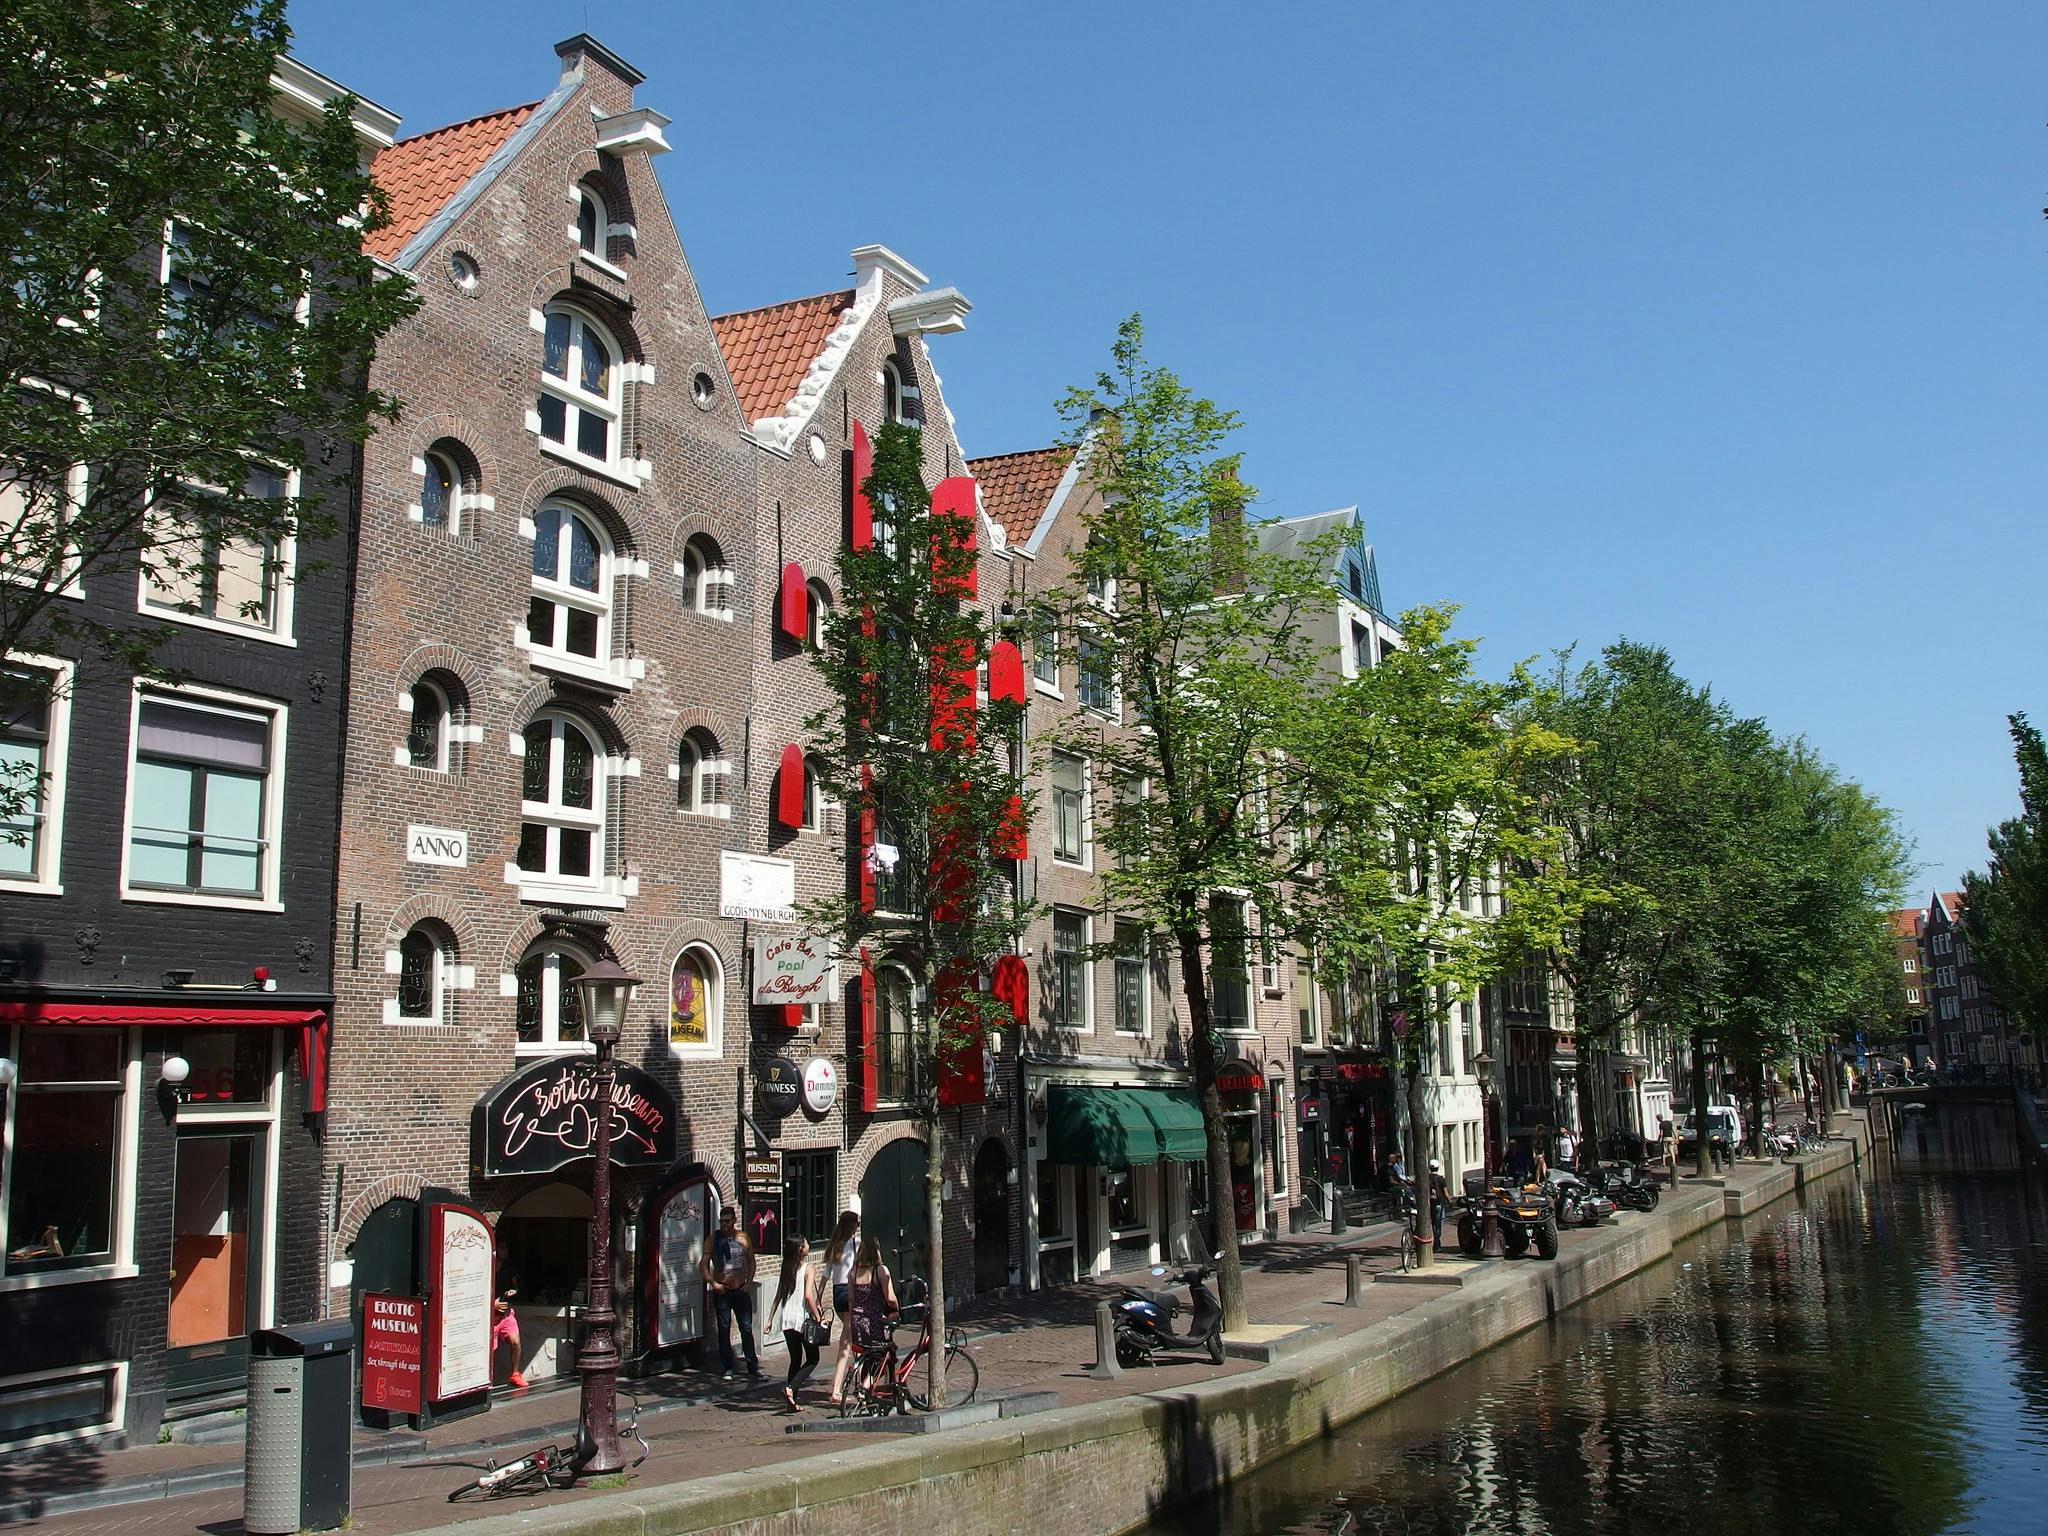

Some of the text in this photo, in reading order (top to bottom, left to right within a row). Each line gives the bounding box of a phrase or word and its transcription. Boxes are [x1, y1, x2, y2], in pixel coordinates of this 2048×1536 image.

[412, 835, 462, 858] ANNO
[796, 939, 817, 959] Bar
[777, 959, 805, 972] Pool
[758, 974, 823, 999] de Burgh
[190, 1067, 235, 1099] 56
[758, 1081, 796, 1093] GUINNESS
[503, 1067, 590, 1156] Erotic
[747, 1163, 777, 1173] MUSEUM
[374, 1300, 415, 1317] EROTIC
[371, 1318, 419, 1334] MUSEUM
[368, 1339, 420, 1356] AMSTERDAM
[367, 1356, 378, 1368] Sex
[378, 1357, 398, 1371] through
[399, 1360, 408, 1370] the
[376, 1376, 387, 1402] 5
